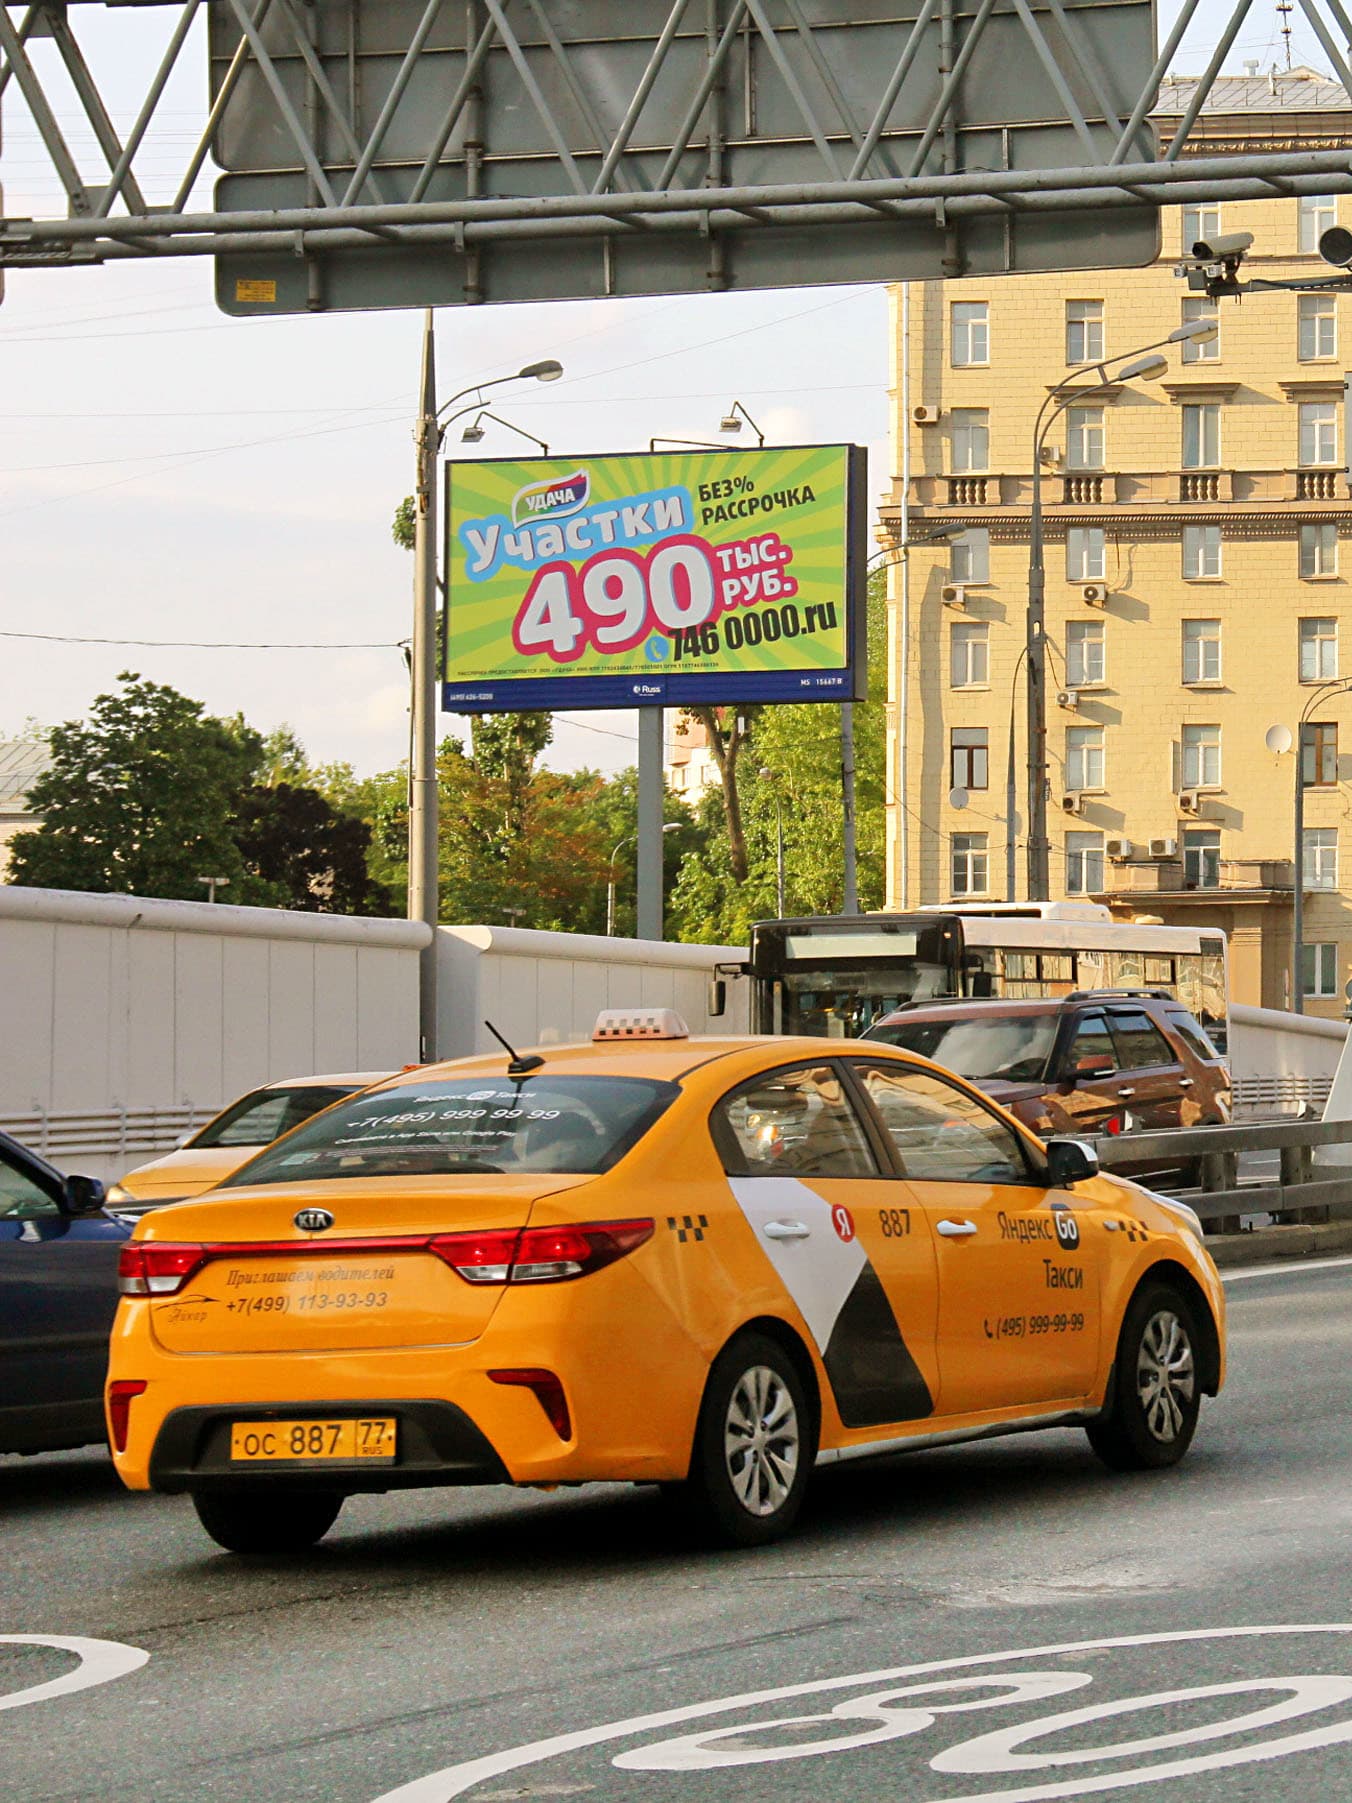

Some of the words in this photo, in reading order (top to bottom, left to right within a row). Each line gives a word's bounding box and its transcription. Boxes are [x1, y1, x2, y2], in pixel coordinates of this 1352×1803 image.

[525, 487, 576, 511] УДАЧА
[698, 476, 755, 503] БЕЗ%
[702, 485, 817, 526] РАССРОЧКА
[465, 496, 684, 574] Участки
[519, 544, 713, 653] 490
[716, 538, 787, 573] ТЫС.
[721, 568, 792, 606] РУБ.
[668, 621, 720, 662] 746
[724, 600, 838, 650] 0000.ru
[346, 1111, 436, 1128] +7(495)
[439, 1109, 487, 1121] 999
[489, 1109, 524, 1120] 99
[526, 1109, 561, 1121] 99
[299, 1213, 327, 1227] KIA
[836, 1208, 851, 1236] Я
[879, 1208, 911, 1238] 887
[997, 1211, 1053, 1244] Яндекс
[1055, 1211, 1077, 1241] Go
[226, 1268, 313, 1289] Приглашаем
[318, 1265, 395, 1283] водителей
[1042, 1258, 1083, 1289] Такси
[226, 1295, 290, 1317] +7(499)
[298, 1292, 388, 1310] 113-93-93
[996, 1316, 1027, 1338] (495)
[1029, 1313, 1085, 1335] 999-99-99
[244, 1433, 276, 1456] ОС
[290, 1424, 342, 1455] 887
[360, 1421, 386, 1445] 77
[361, 1446, 383, 1455] RUS
